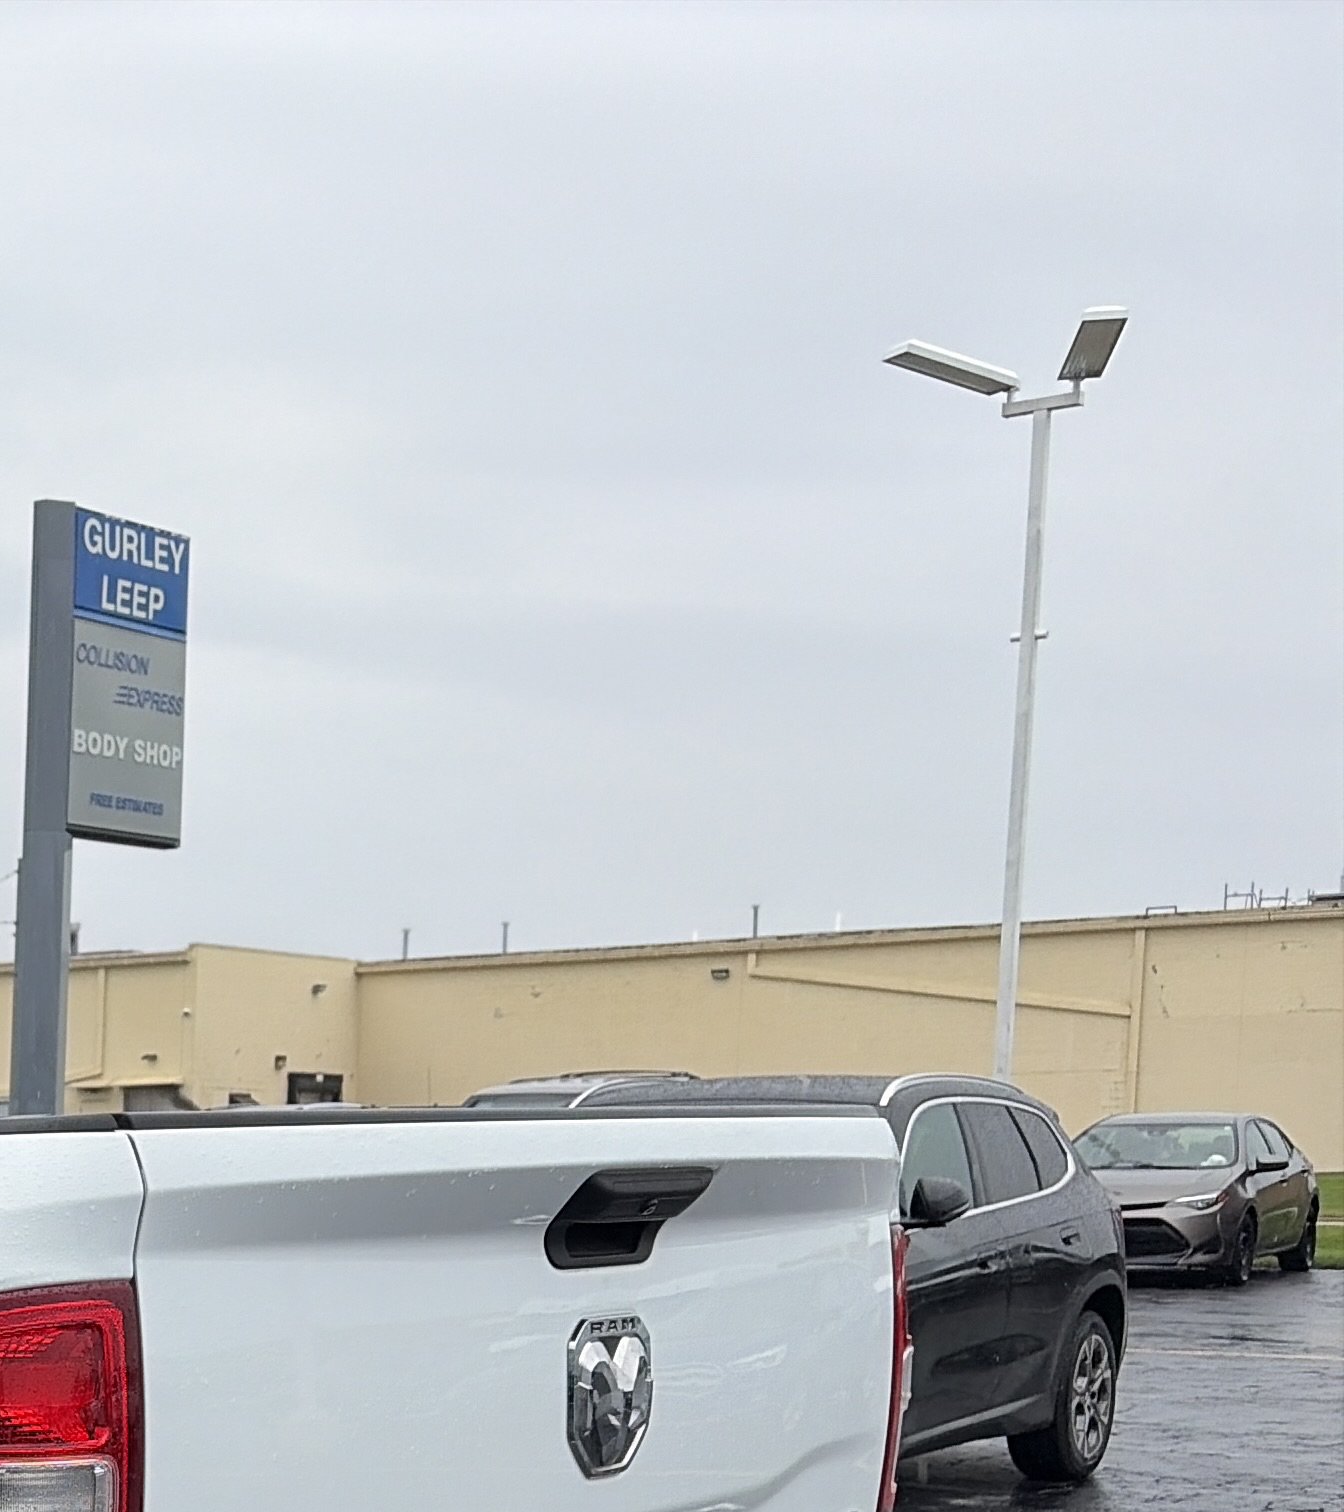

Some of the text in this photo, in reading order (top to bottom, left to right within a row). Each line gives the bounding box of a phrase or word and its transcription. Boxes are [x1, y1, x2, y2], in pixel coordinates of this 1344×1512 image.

[83, 517, 185, 575] GURLEY
[101, 574, 165, 621] LEEP
[76, 643, 151, 676] COLLISION
[113, 685, 185, 717] EXPRESS
[72, 728, 182, 769] BODY SHOP
[90, 792, 164, 816] FREE ESTIMATES
[590, 1318, 636, 1335] RAM
